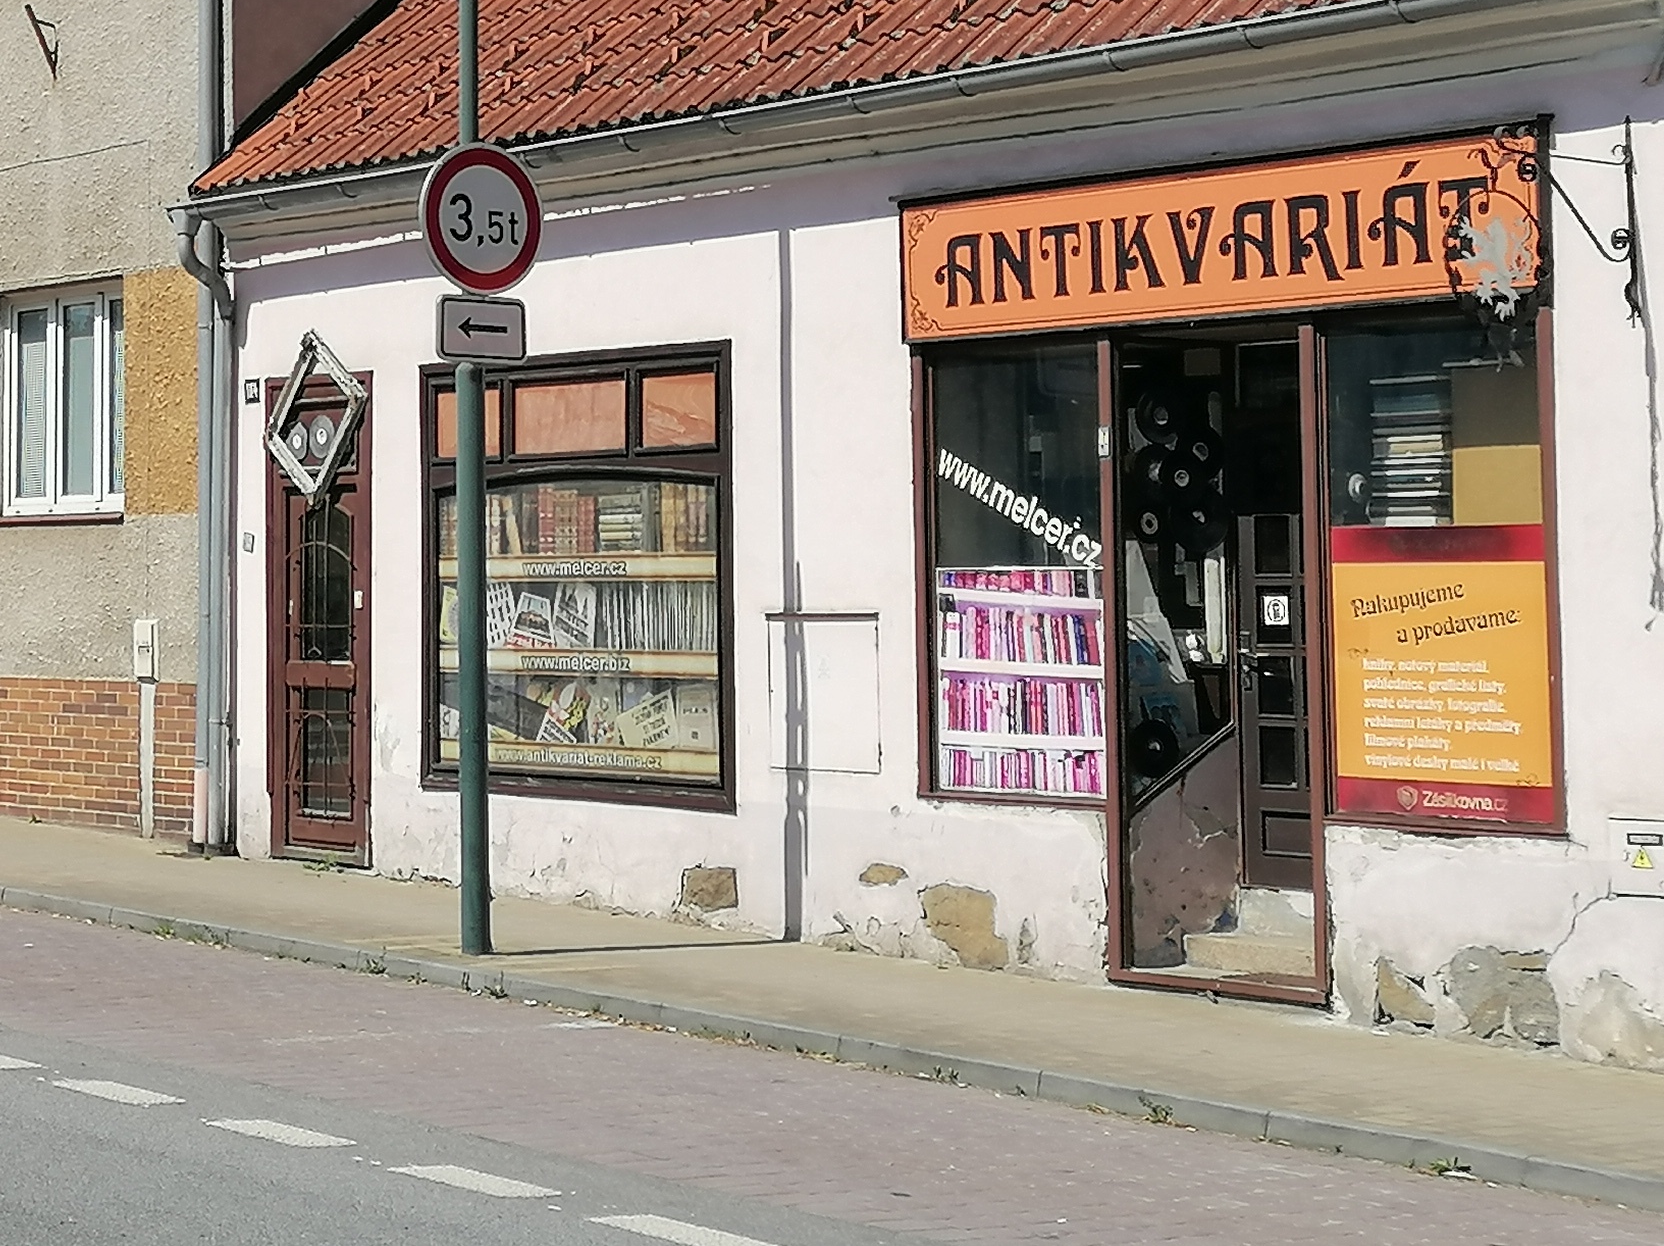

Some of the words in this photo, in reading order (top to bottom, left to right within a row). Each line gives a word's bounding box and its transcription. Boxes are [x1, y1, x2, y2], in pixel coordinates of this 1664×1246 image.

[933, 160, 1493, 309] ANTIKVARIÁT
[938, 448, 1103, 568] www.melcer.cz
[521, 560, 627, 576] www.melcer.cz
[1397, 628, 1409, 644] a
[520, 655, 631, 672] www.melcer.biz
